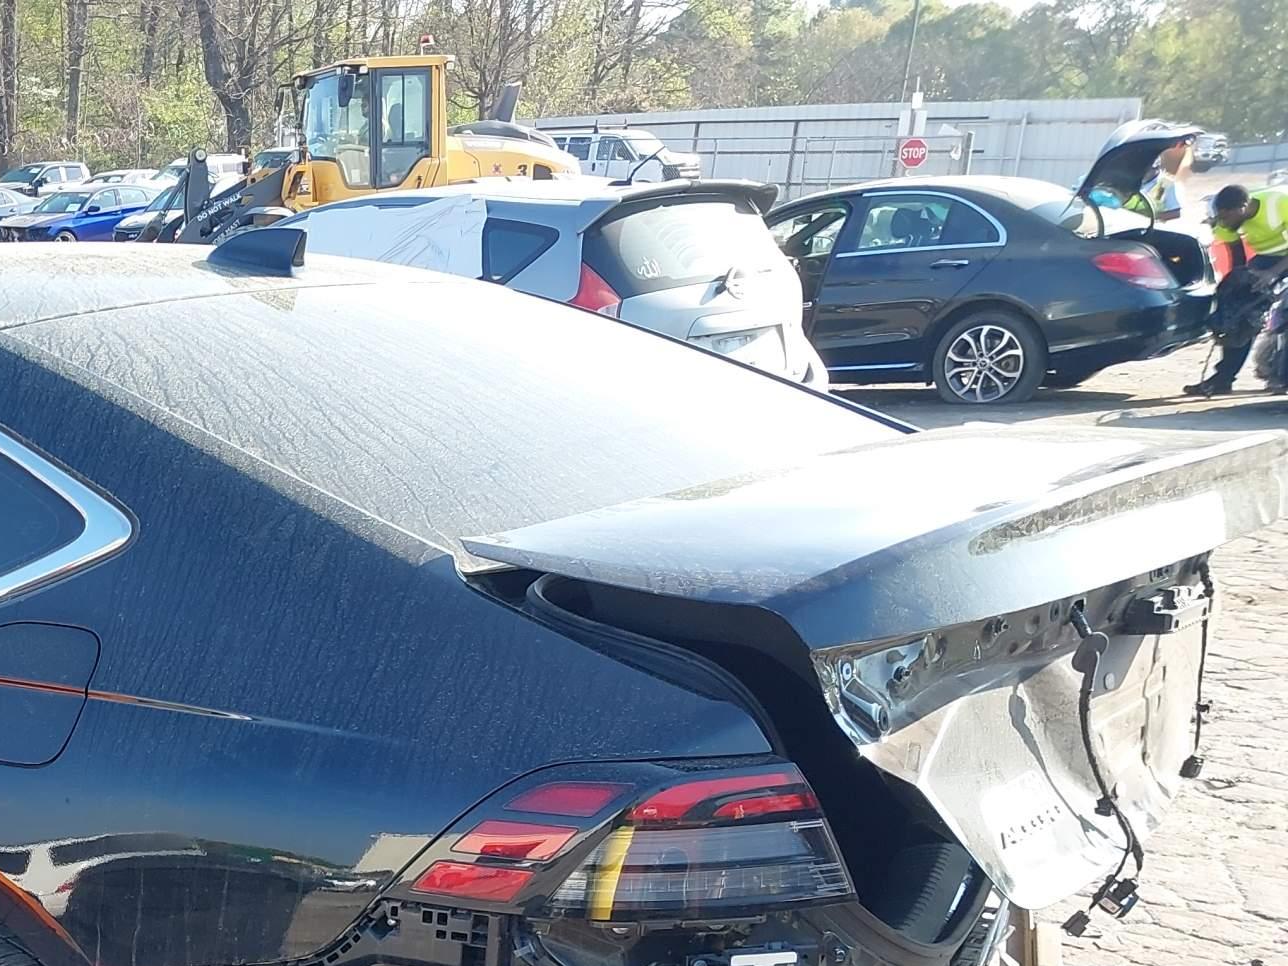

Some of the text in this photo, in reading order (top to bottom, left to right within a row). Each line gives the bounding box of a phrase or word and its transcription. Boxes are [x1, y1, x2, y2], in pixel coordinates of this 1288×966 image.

[902, 147, 925, 159] STOP
[197, 192, 242, 222] DO NOT WALK
